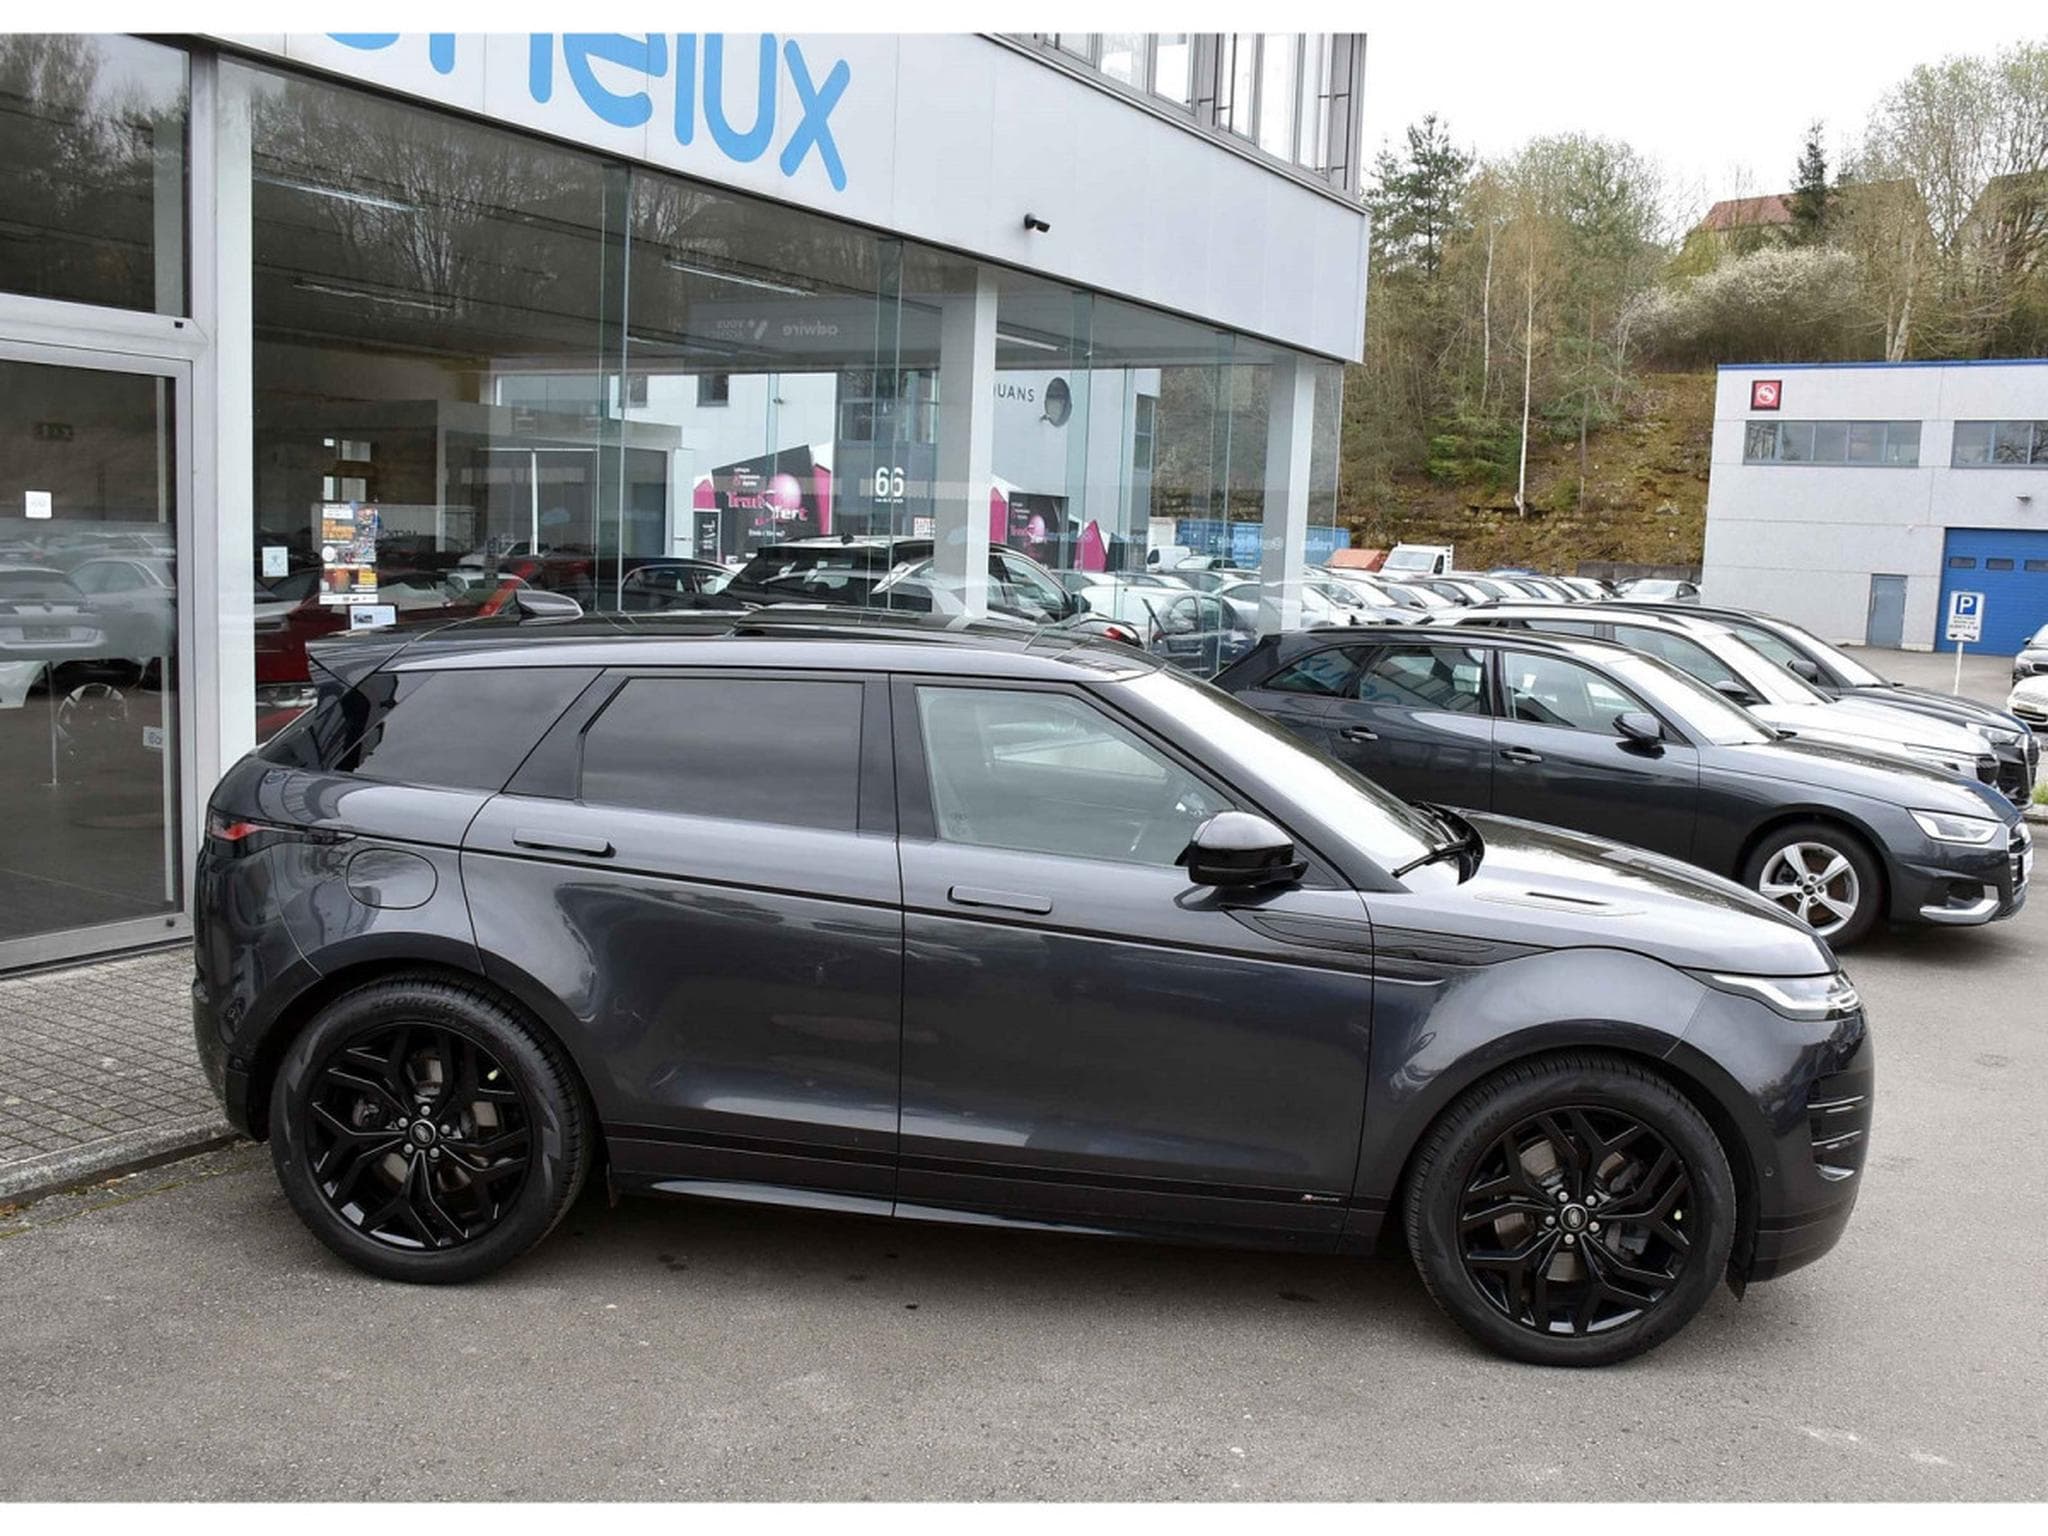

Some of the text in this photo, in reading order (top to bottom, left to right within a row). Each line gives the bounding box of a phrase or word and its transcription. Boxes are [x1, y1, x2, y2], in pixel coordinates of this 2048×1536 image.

[993, 383, 1035, 402] UANS
[875, 466, 905, 497] 66
[1958, 596, 1974, 614] P
